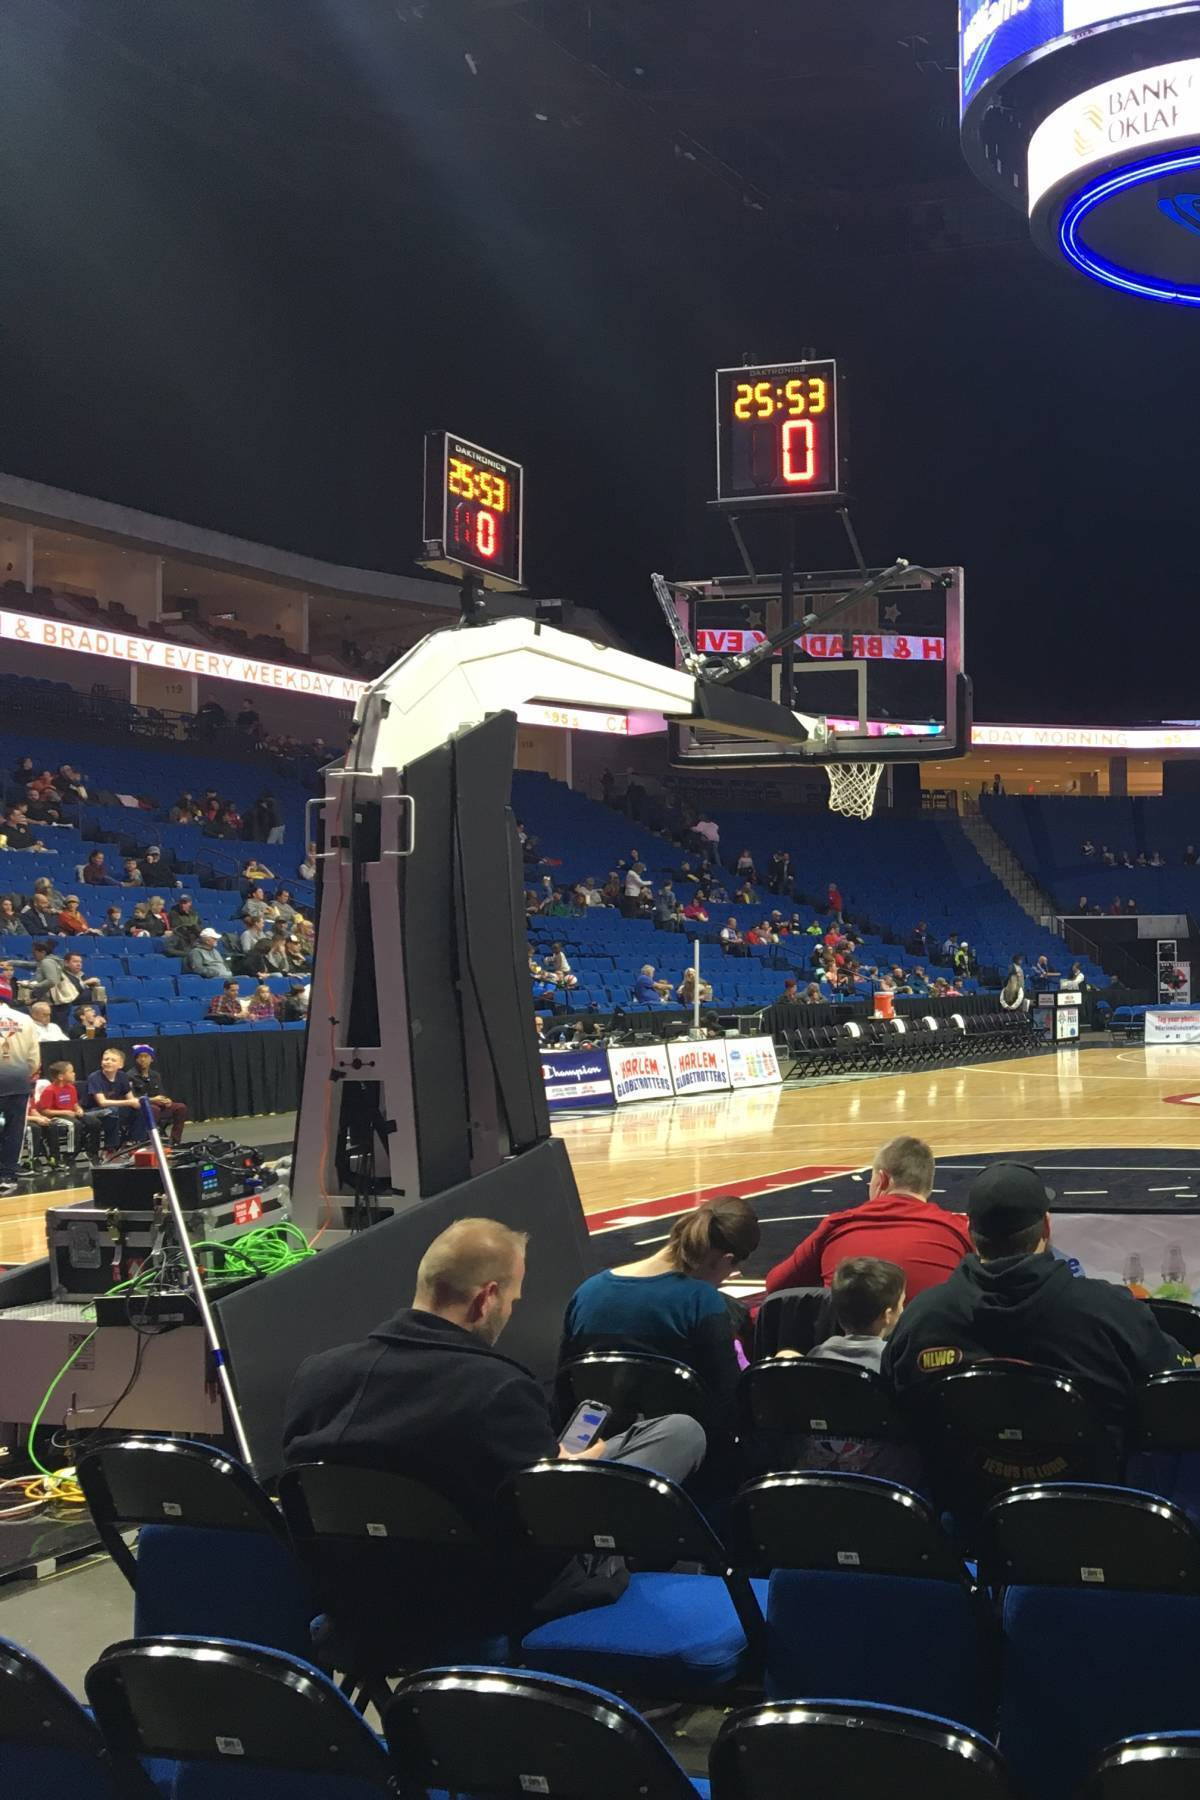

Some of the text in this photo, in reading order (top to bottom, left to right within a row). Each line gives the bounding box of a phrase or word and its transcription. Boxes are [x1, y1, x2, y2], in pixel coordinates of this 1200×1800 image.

[749, 365, 806, 377] DAKTRONICS
[734, 377, 826, 419] 25:53
[455, 444, 507, 473] DAKTRONICS
[782, 418, 814, 481] 0
[448, 457, 506, 512] 25:53
[476, 510, 495, 556] 0
[15, 618, 31, 639] &
[43, 623, 155, 662] BRADLEY
[164, 647, 233, 676] EVERY
[242, 663, 335, 695] WEEKDAY
[1034, 730, 1128, 746] MORNING
[540, 1064, 602, 1081] Champion
[620, 1057, 660, 1079] HARLEM
[678, 1051, 718, 1073] HARLEM
[617, 1076, 670, 1097] GLOBETROTTERS
[675, 1070, 727, 1090] GLOBETROTTERS
[982, 1457, 1021, 1479] JESUS
